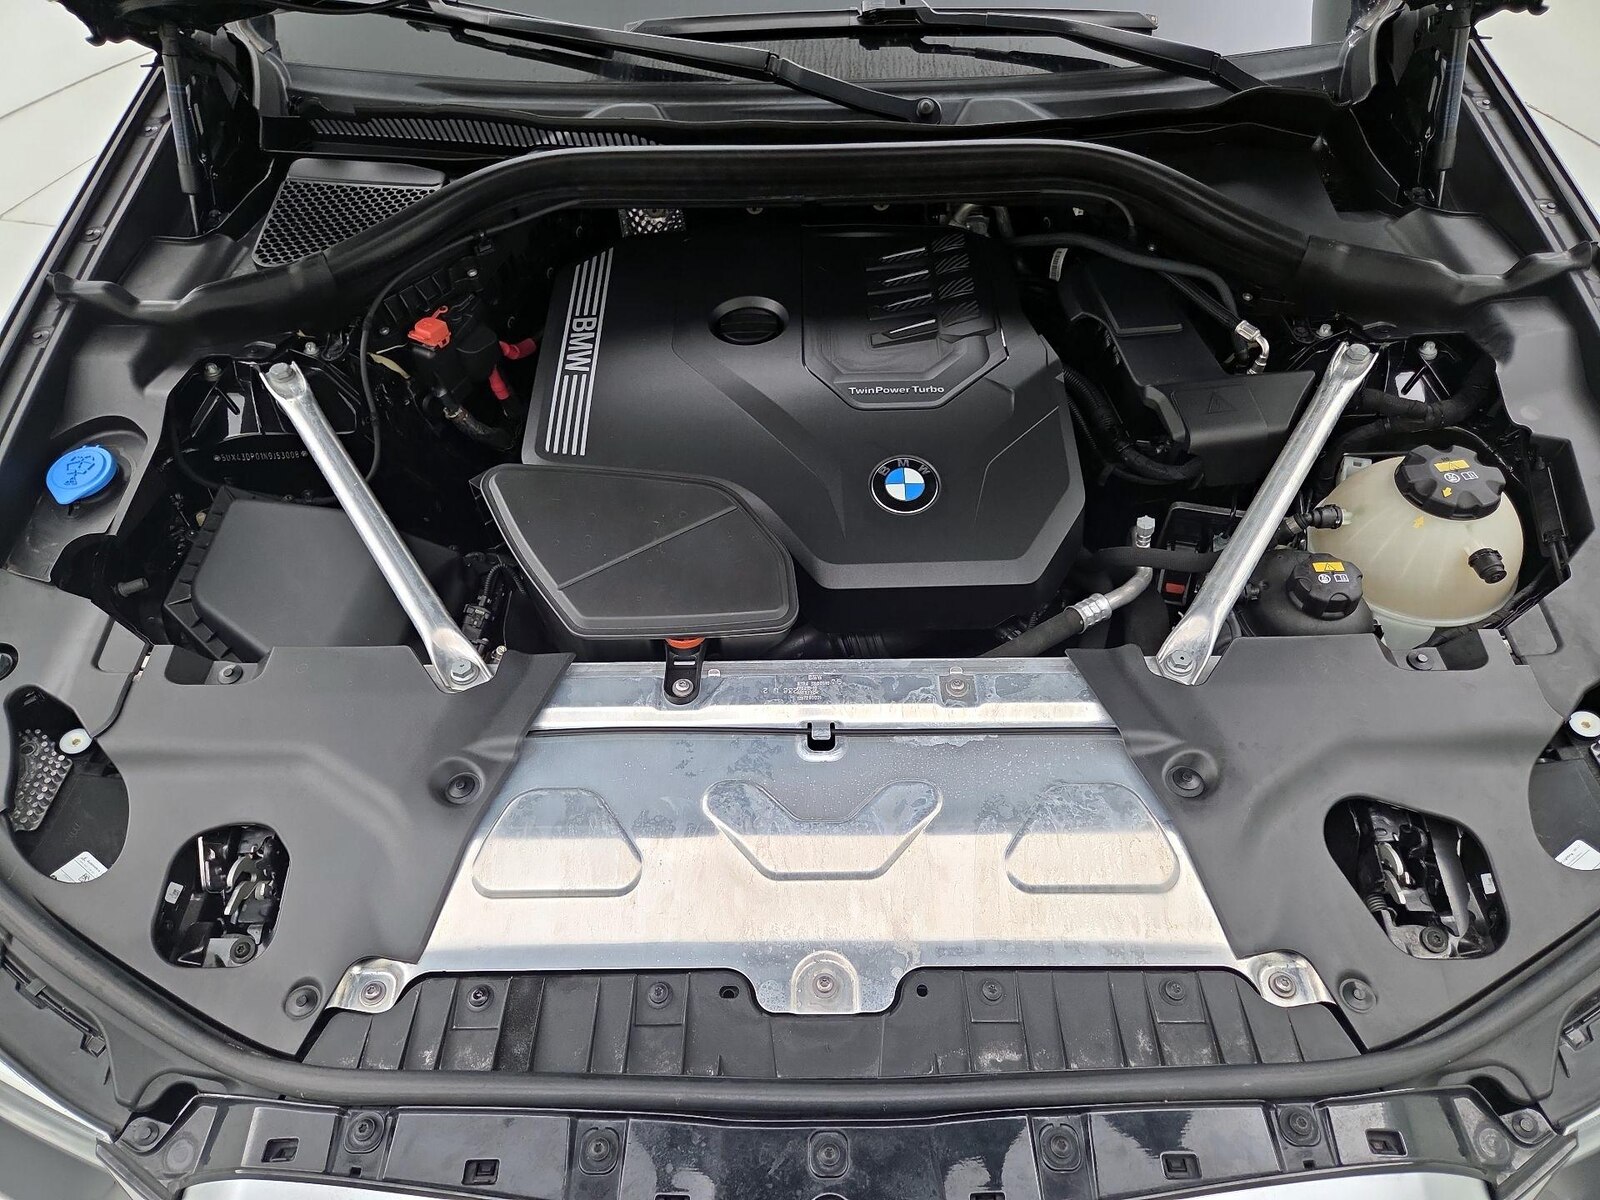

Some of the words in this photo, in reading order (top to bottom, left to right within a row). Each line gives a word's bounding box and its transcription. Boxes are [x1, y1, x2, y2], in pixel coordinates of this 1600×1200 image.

[564, 317, 598, 371] BMW
[848, 386, 910, 395] TwinPower
[911, 385, 945, 393] Turbo
[878, 459, 931, 476] BMW
